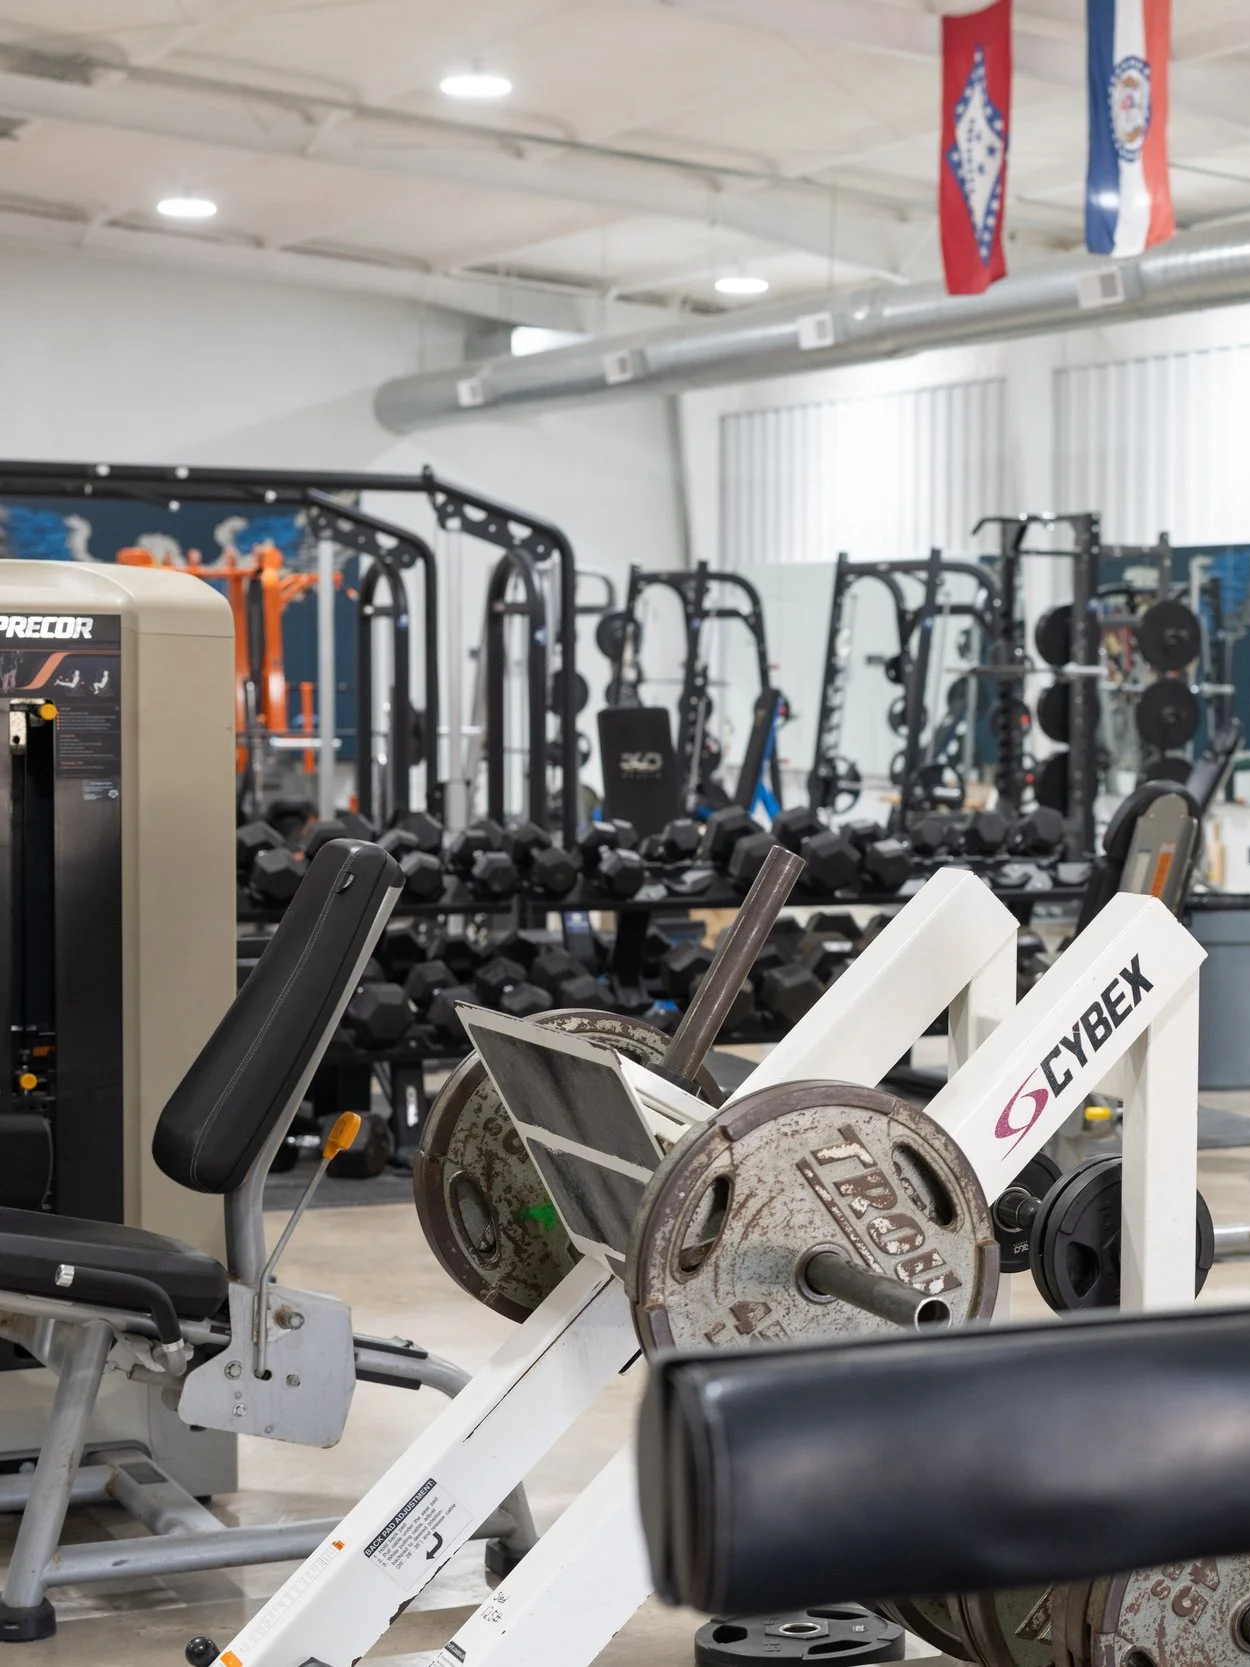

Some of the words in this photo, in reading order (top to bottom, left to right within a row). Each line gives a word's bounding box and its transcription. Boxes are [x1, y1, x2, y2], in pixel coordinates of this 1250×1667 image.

[0, 615, 93, 639] PRECOR
[1040, 953, 1154, 1098] CYBEX
[365, 1536, 383, 1556] BACK
[382, 1523, 396, 1537] PAD
[395, 1480, 435, 1523] ADJUSTMENT:
[378, 1542, 388, 1553] Hold
[388, 1532, 398, 1543] back
[399, 1523, 407, 1532] pad
[382, 1548, 391, 1557] Pull
[392, 1537, 402, 1548] cable
[403, 1524, 413, 1536] under
[421, 1506, 430, 1516] seat
[387, 1549, 398, 1561] While
[399, 1534, 412, 1549] pulling
[424, 1508, 436, 1521] adjust
[414, 1526, 427, 1541] desired
[428, 1510, 442, 1526] position
[423, 1531, 431, 1540] and
[431, 1515, 445, 1531] release
[445, 1503, 456, 1516] cable
